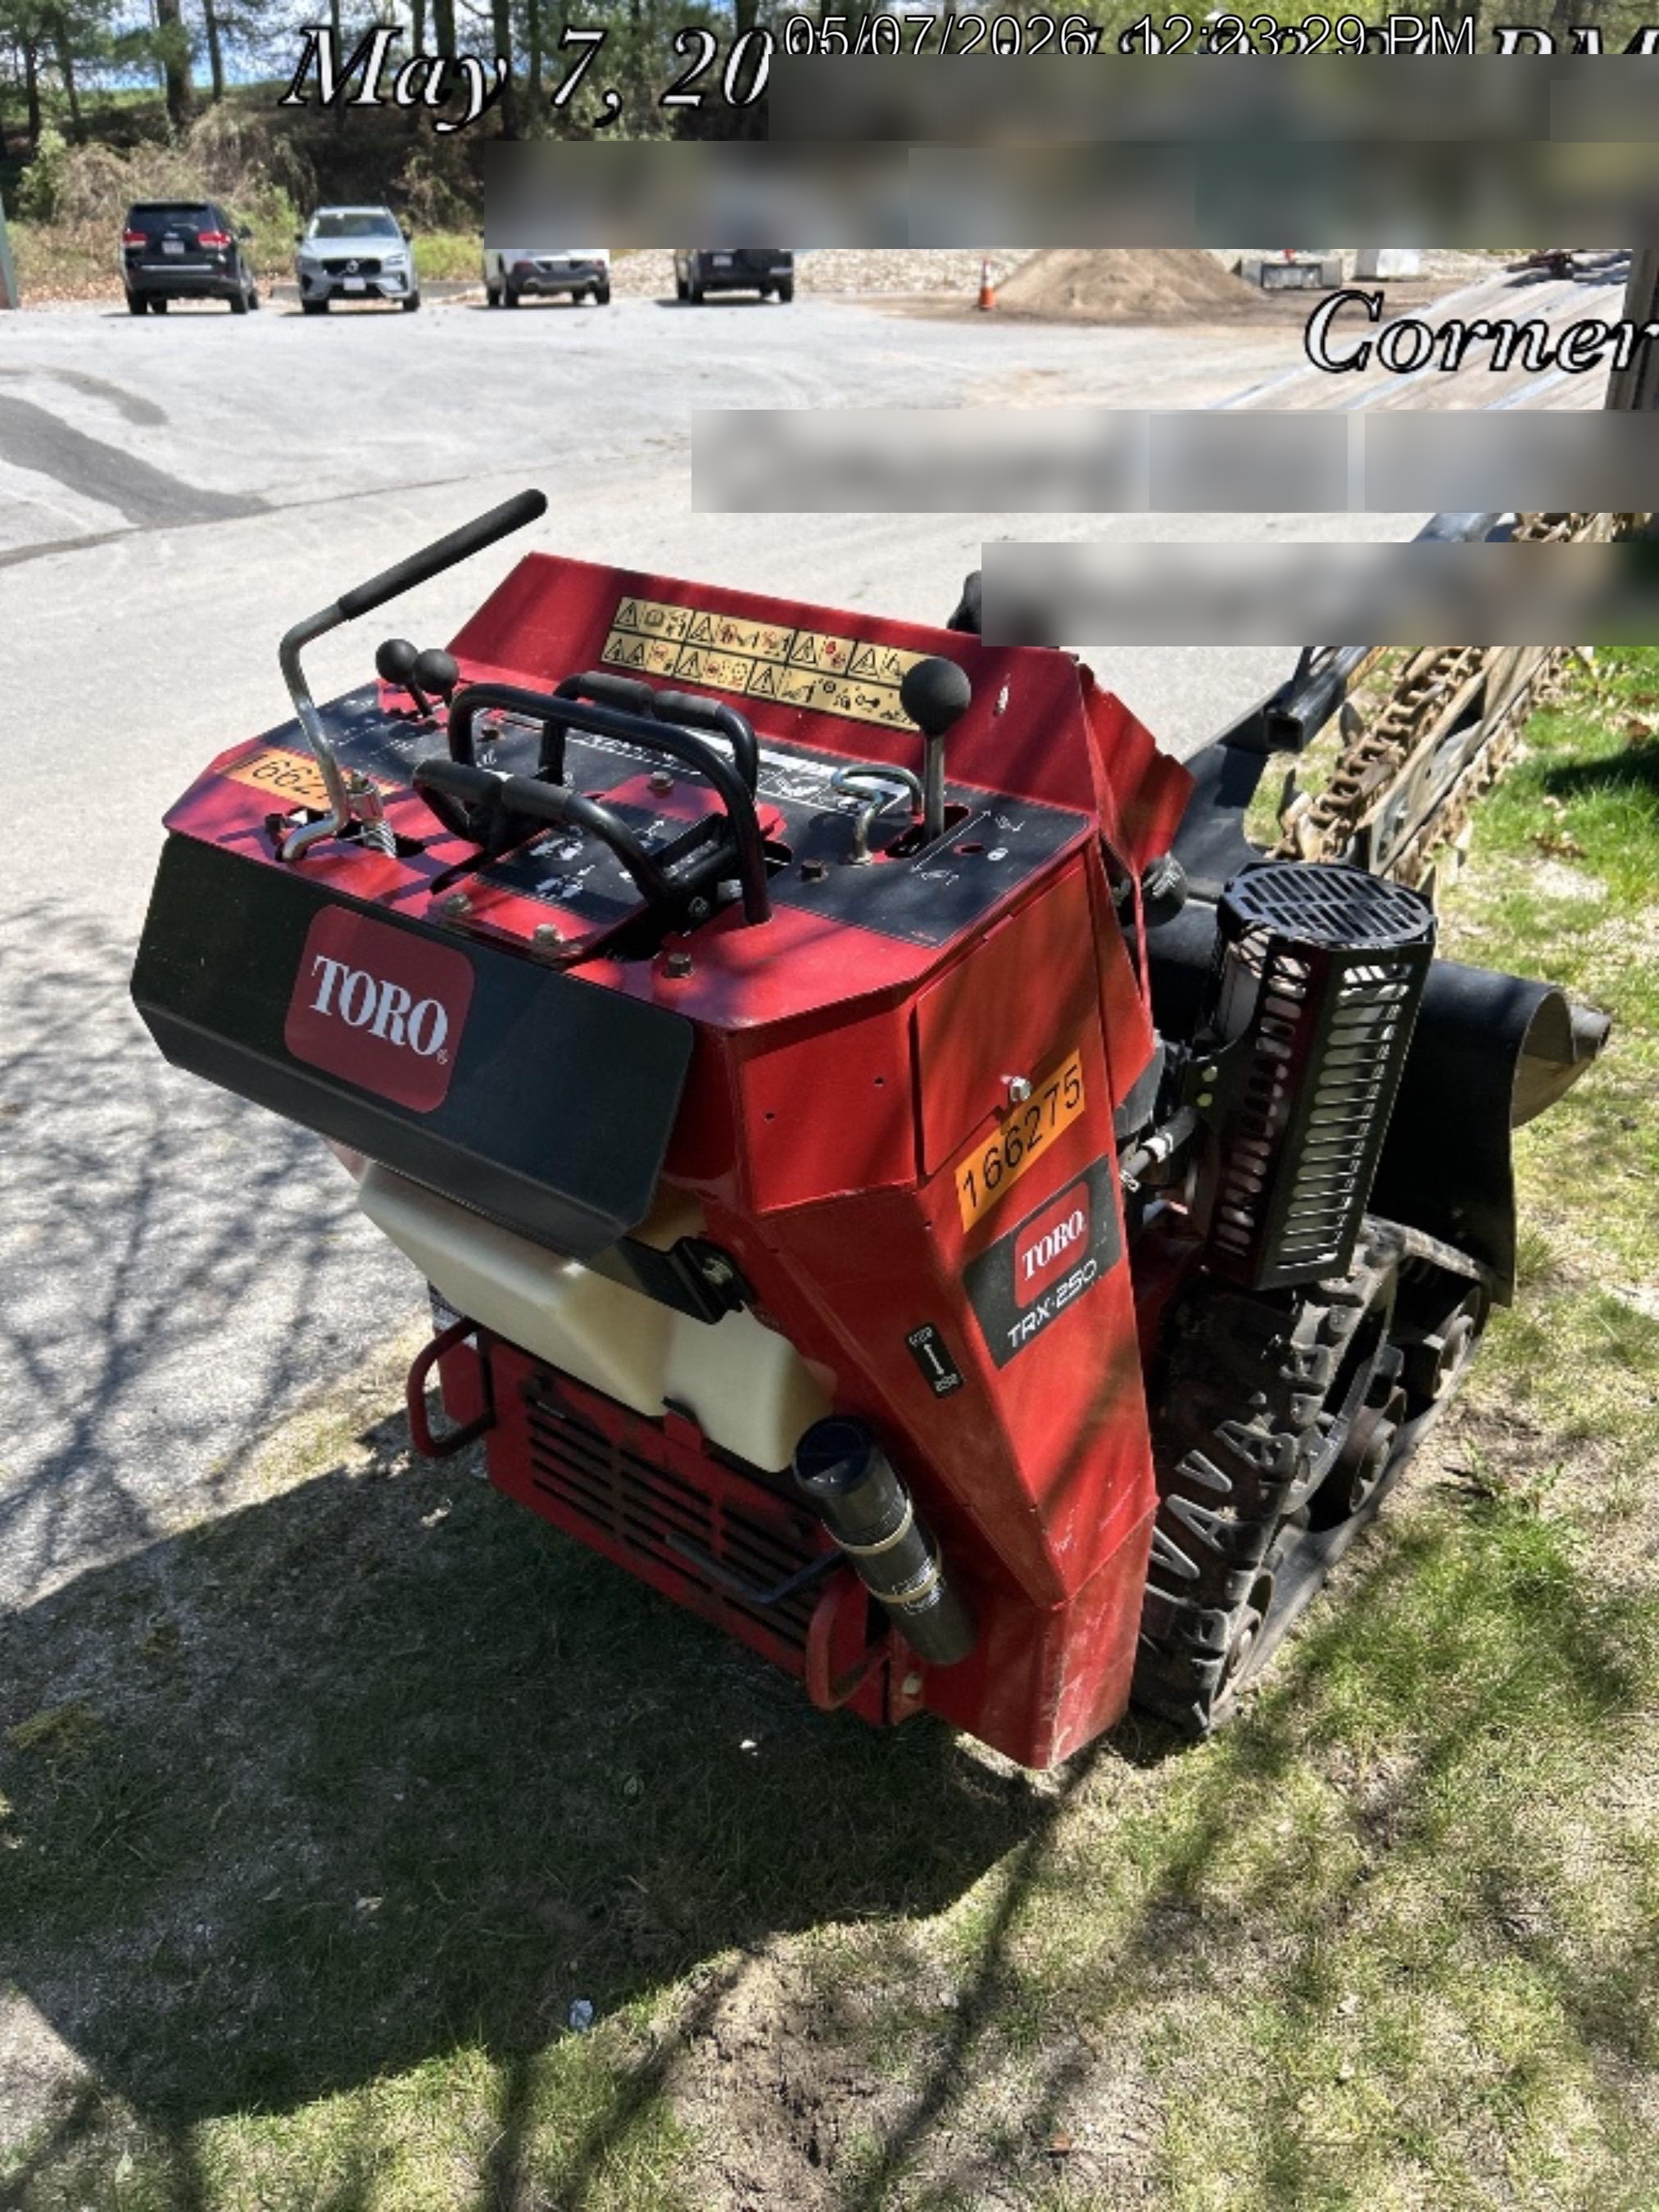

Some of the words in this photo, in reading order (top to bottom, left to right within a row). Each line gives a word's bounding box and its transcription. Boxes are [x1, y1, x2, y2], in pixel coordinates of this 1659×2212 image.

[308, 954, 449, 1057] TORO
[963, 1064, 1081, 1208] 166275
[1022, 1209, 1085, 1281] TORO
